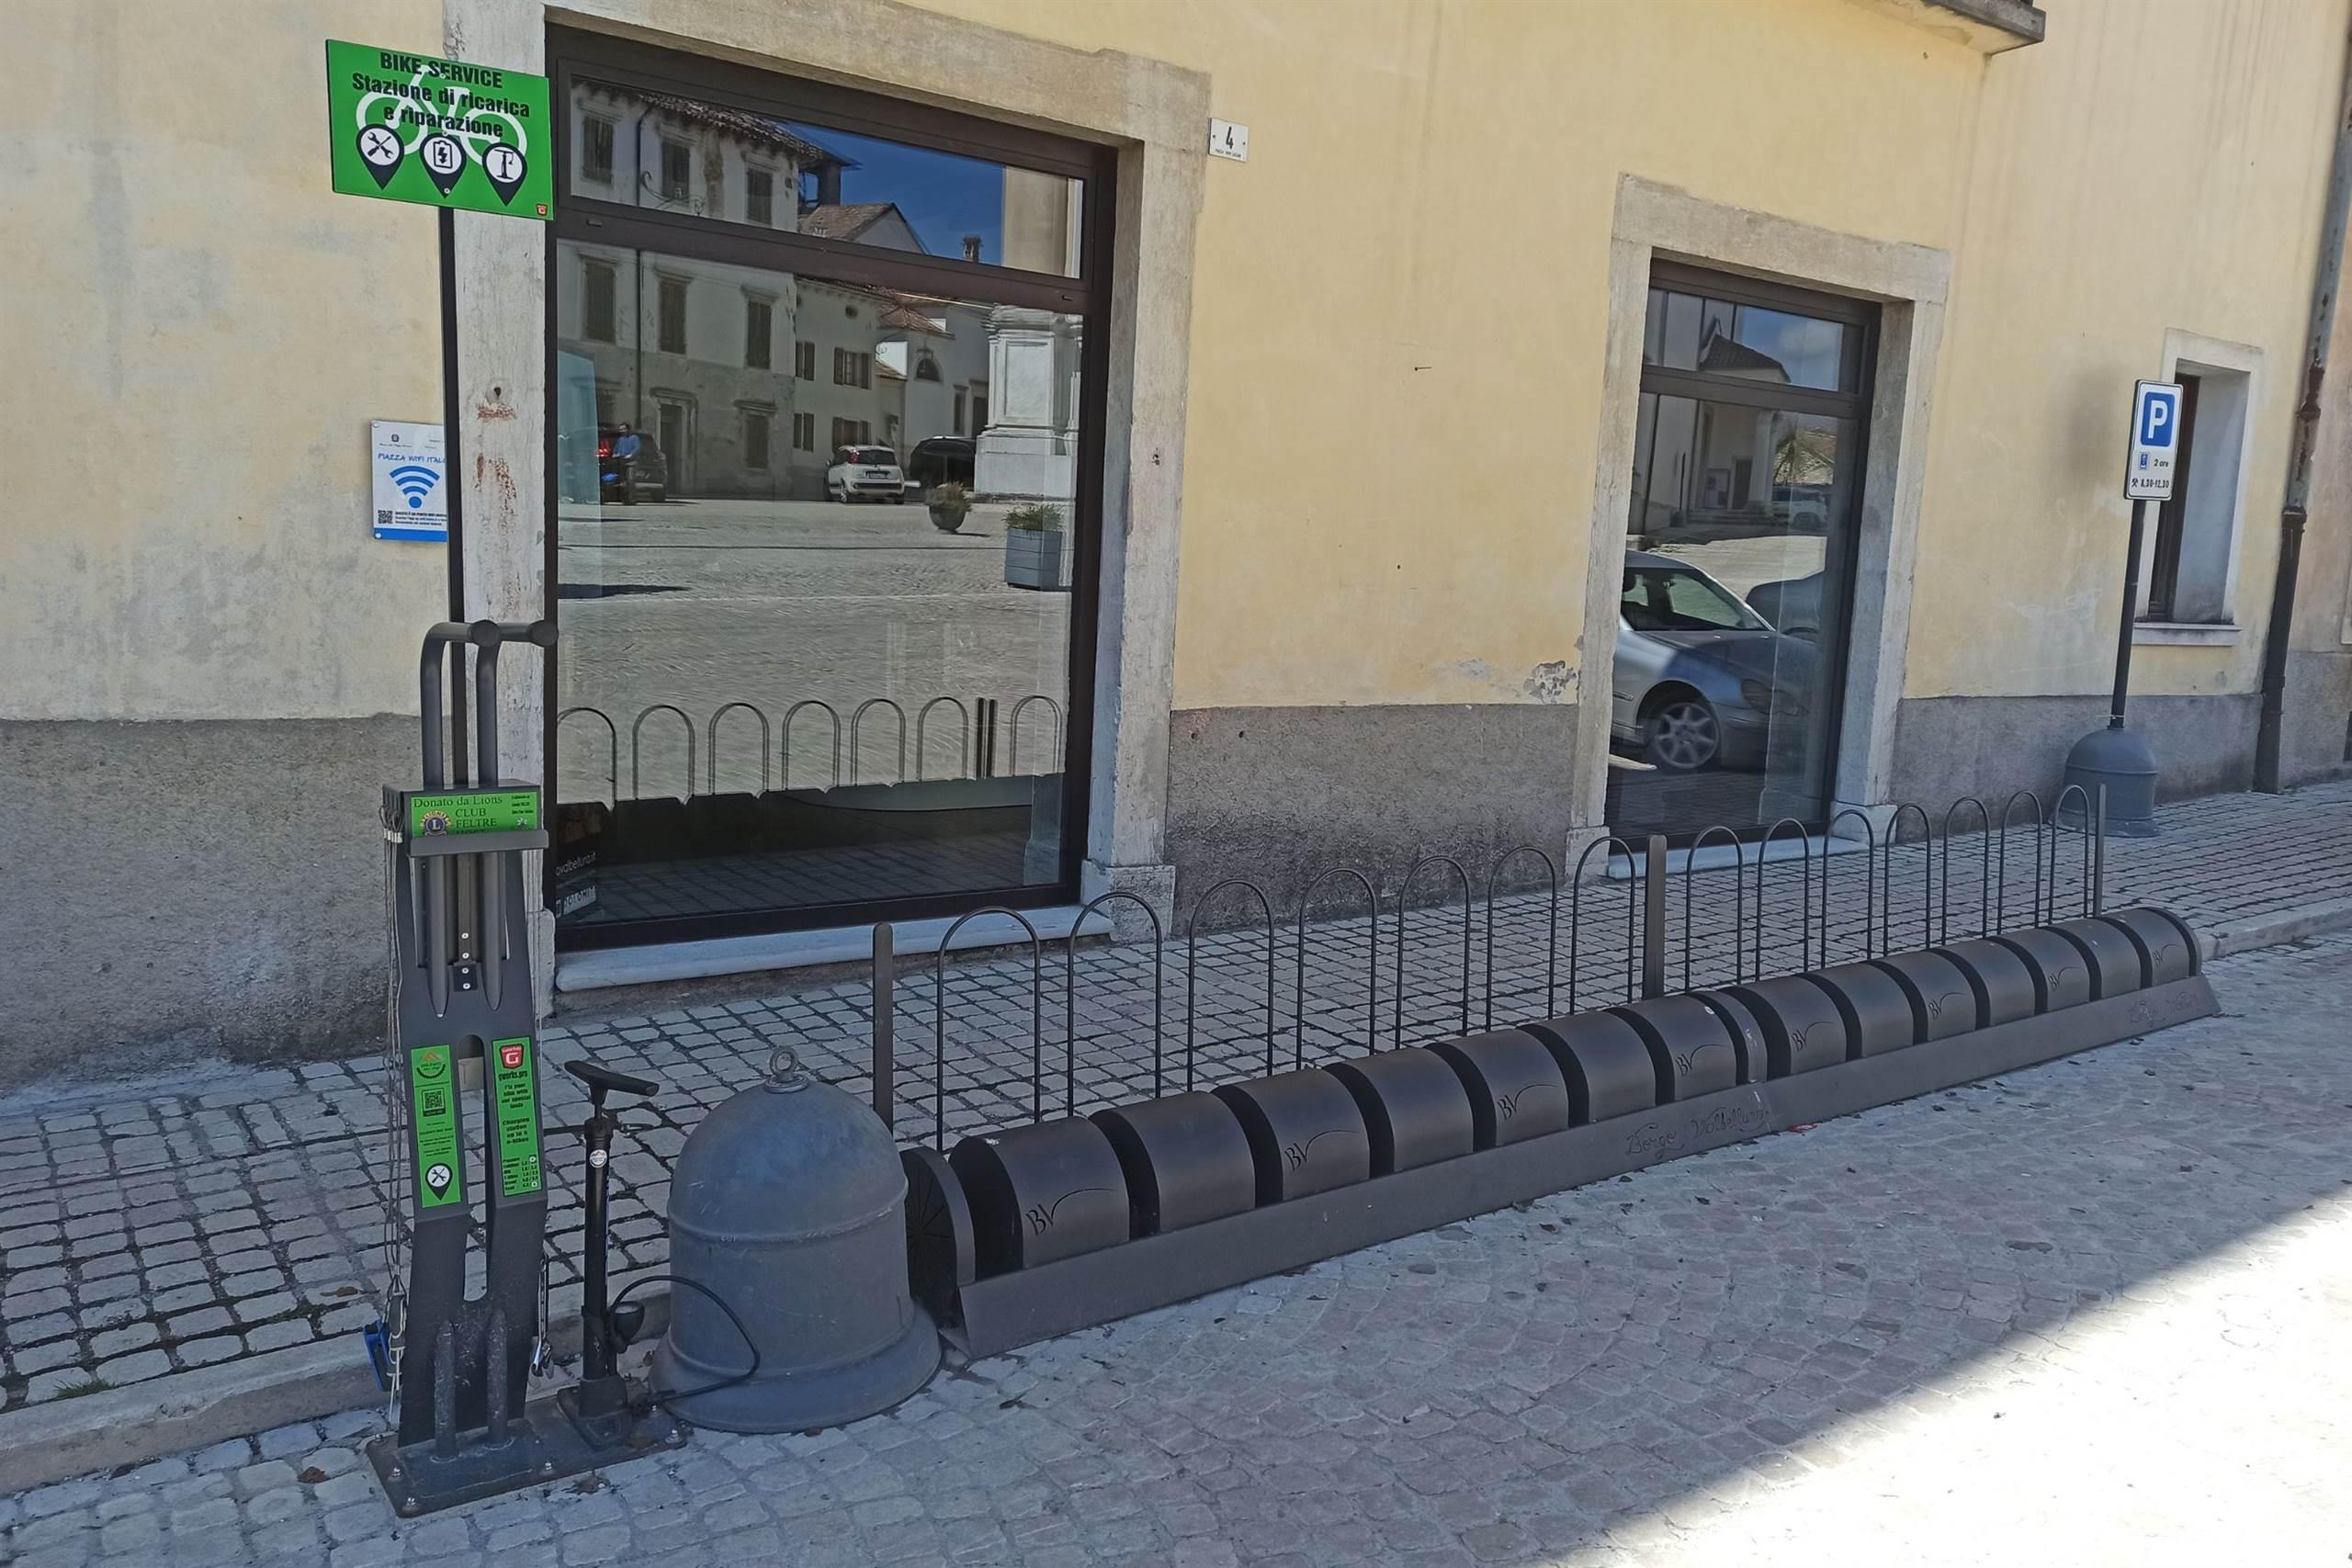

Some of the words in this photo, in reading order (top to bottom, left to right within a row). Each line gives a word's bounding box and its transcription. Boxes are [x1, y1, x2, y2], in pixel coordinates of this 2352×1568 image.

[380, 52, 422, 74] BIKE
[428, 61, 503, 88] SERVICE
[352, 73, 433, 102] Stazione
[438, 87, 455, 106] di
[462, 93, 530, 118] ricarica
[384, 106, 394, 120] e
[401, 107, 503, 138] riparazione
[1226, 126, 1234, 150] 4
[2147, 400, 2169, 439] P
[378, 453, 405, 461] PIAZZA
[2154, 458, 2159, 467] 2
[413, 798, 453, 809] Donato
[456, 795, 469, 807] da
[472, 795, 503, 805] Lions
[455, 807, 487, 818] CLUB
[456, 818, 497, 829] FELTRE
